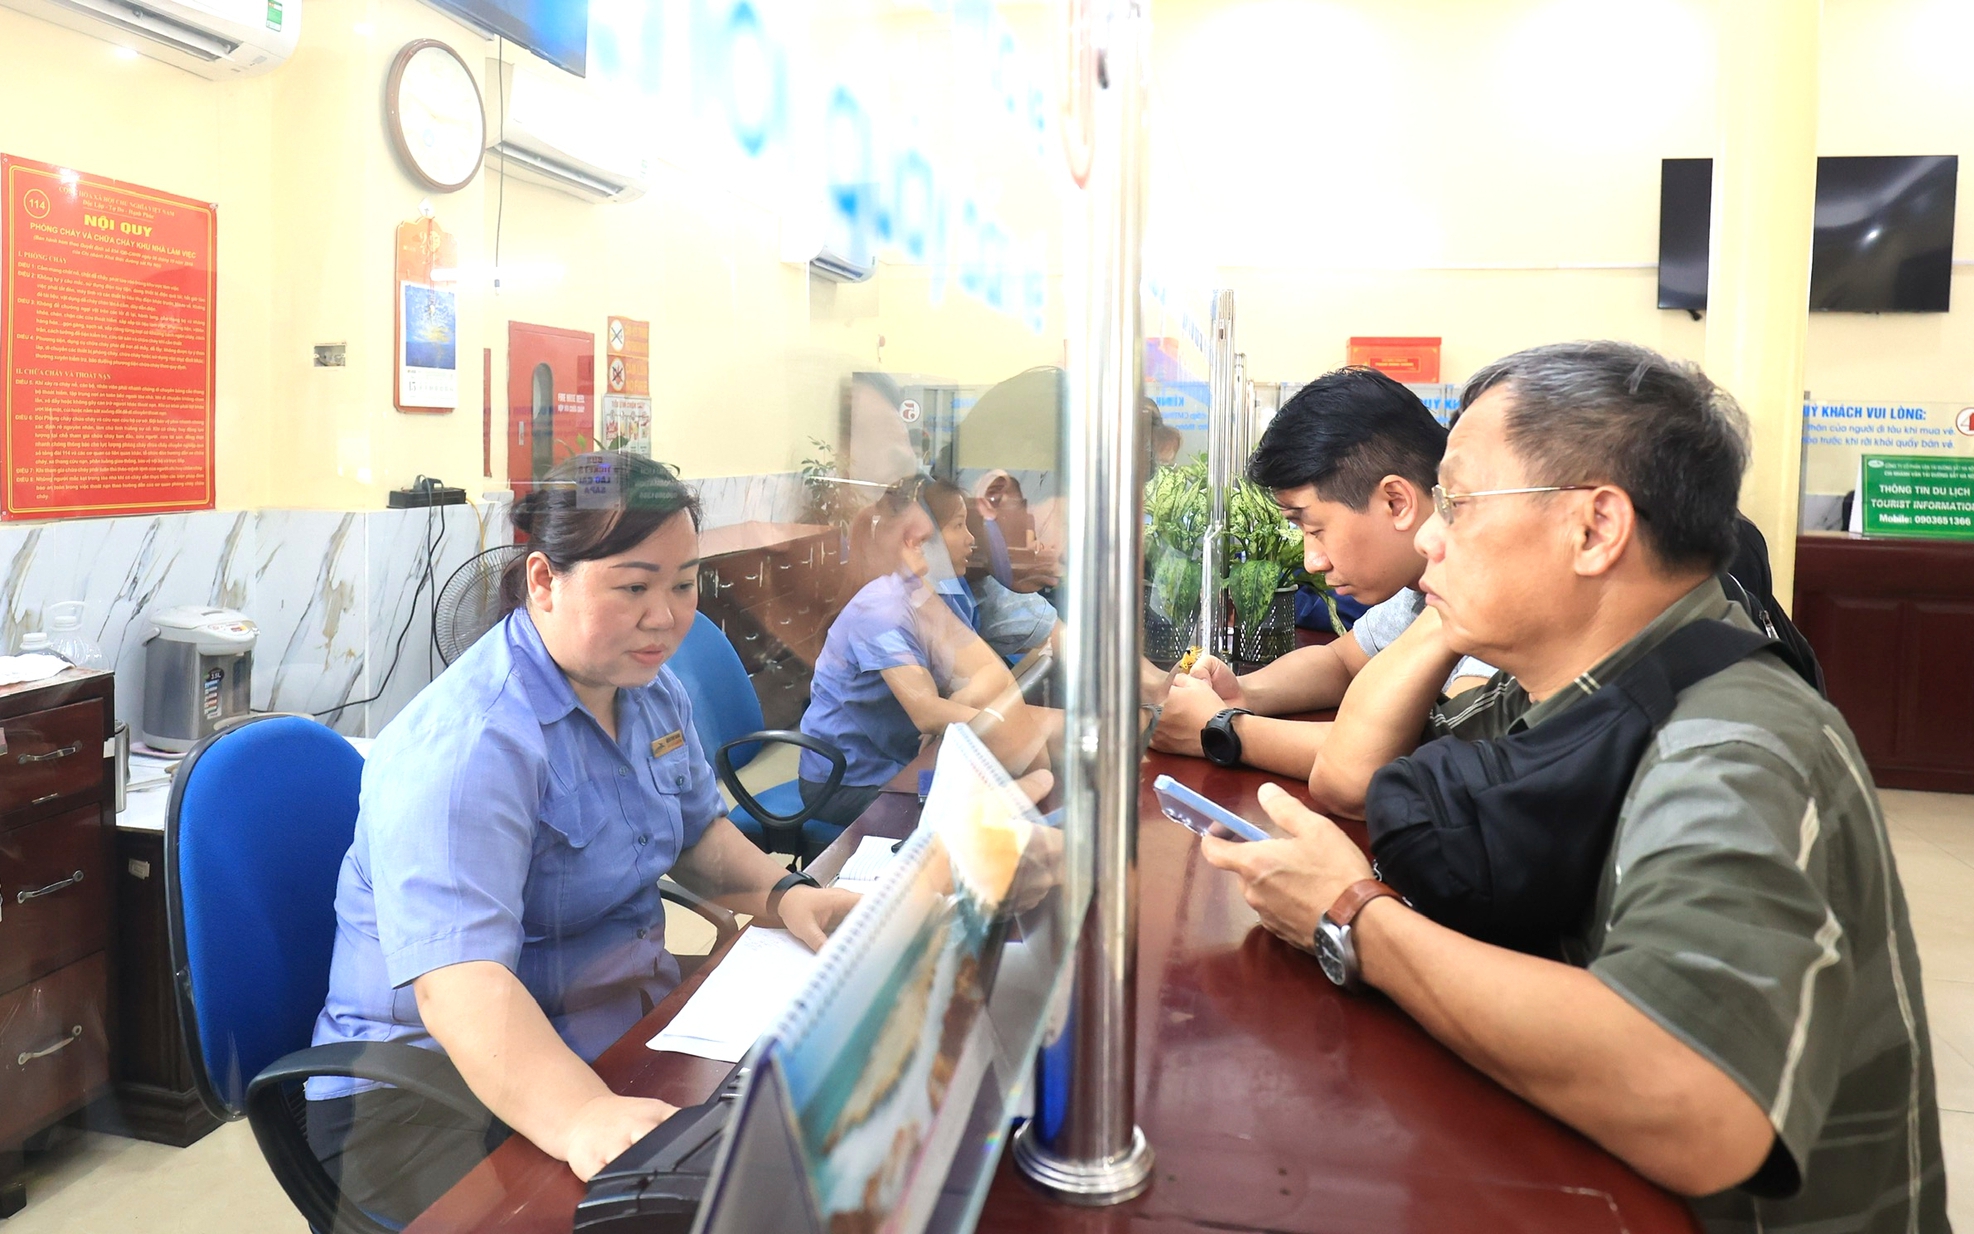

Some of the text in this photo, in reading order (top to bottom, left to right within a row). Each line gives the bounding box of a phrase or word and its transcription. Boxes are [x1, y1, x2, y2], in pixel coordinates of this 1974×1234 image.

[28, 197, 45, 209] 114
[84, 211, 152, 238] NỘI QUY
[30, 221, 196, 259] PHÒNG CHÁY VÀ CHỮA CHÁY KHU NHÀ LÀM VIỆC
[1803, 403, 1926, 420] UÝ KHÁCH VUI LÒNG:
[1904, 426, 1917, 434] khi
[1920, 427, 1940, 435] mua
[1845, 437, 1858, 445] khi
[1879, 483, 1970, 498] THÔNG TIN DU LỊCH
[1871, 499, 1911, 509] TOURIST
[1879, 514, 1912, 524] Mobile:
